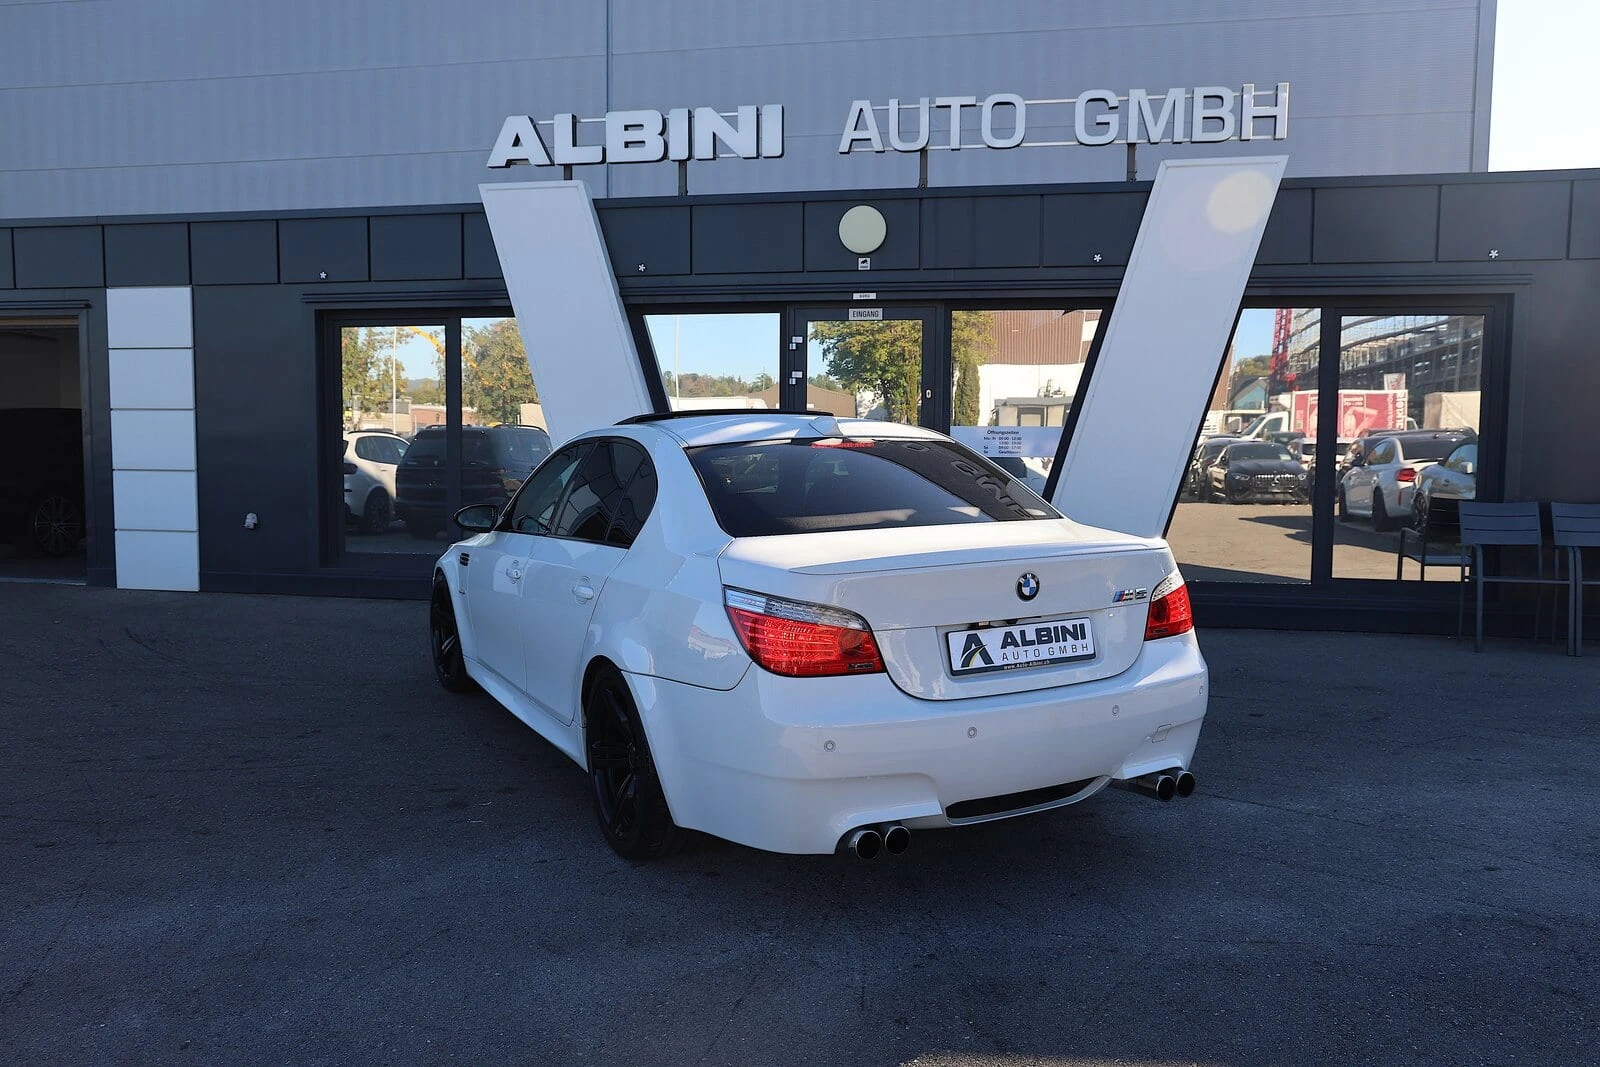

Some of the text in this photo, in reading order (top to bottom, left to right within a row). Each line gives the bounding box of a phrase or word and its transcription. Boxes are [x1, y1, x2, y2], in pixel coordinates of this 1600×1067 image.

[486, 82, 1290, 168] ALBINI AUTO GMBH
[1001, 623, 1087, 650] ALBINI
[1002, 643, 1089, 662] AUTO GMBH
